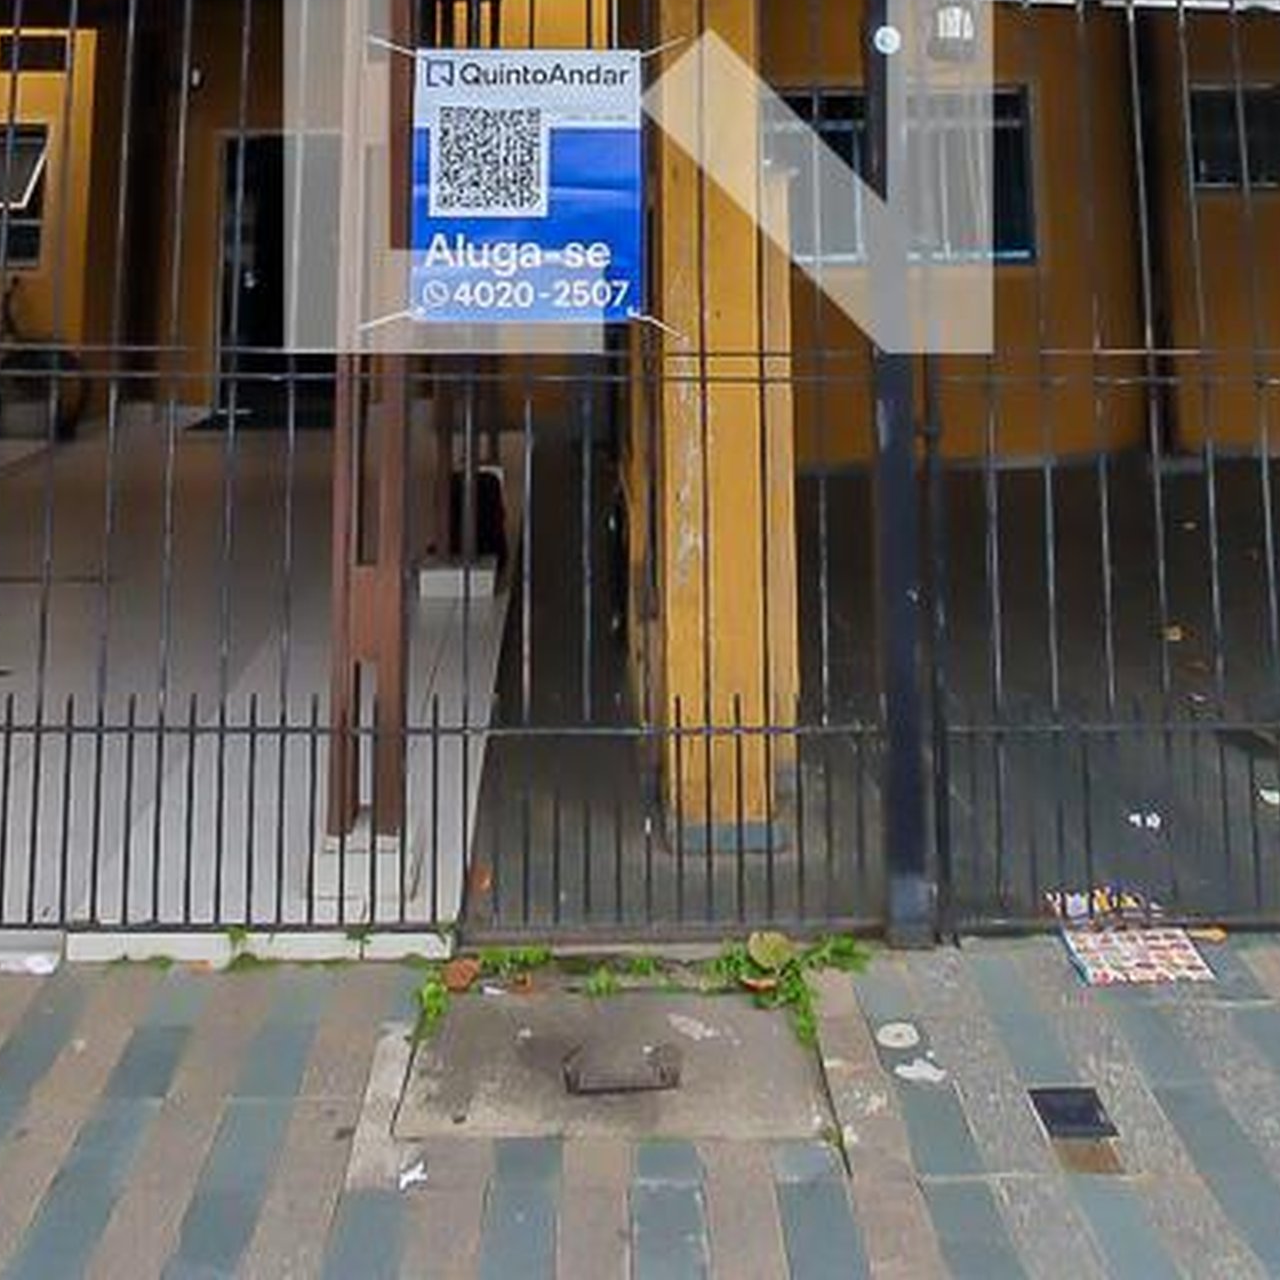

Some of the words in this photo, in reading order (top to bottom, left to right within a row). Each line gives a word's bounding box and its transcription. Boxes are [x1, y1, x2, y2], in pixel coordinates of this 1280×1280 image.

[458, 62, 630, 86] QuintoAndar
[424, 232, 612, 277] Aluga-se
[453, 280, 630, 308] 4020-2507
